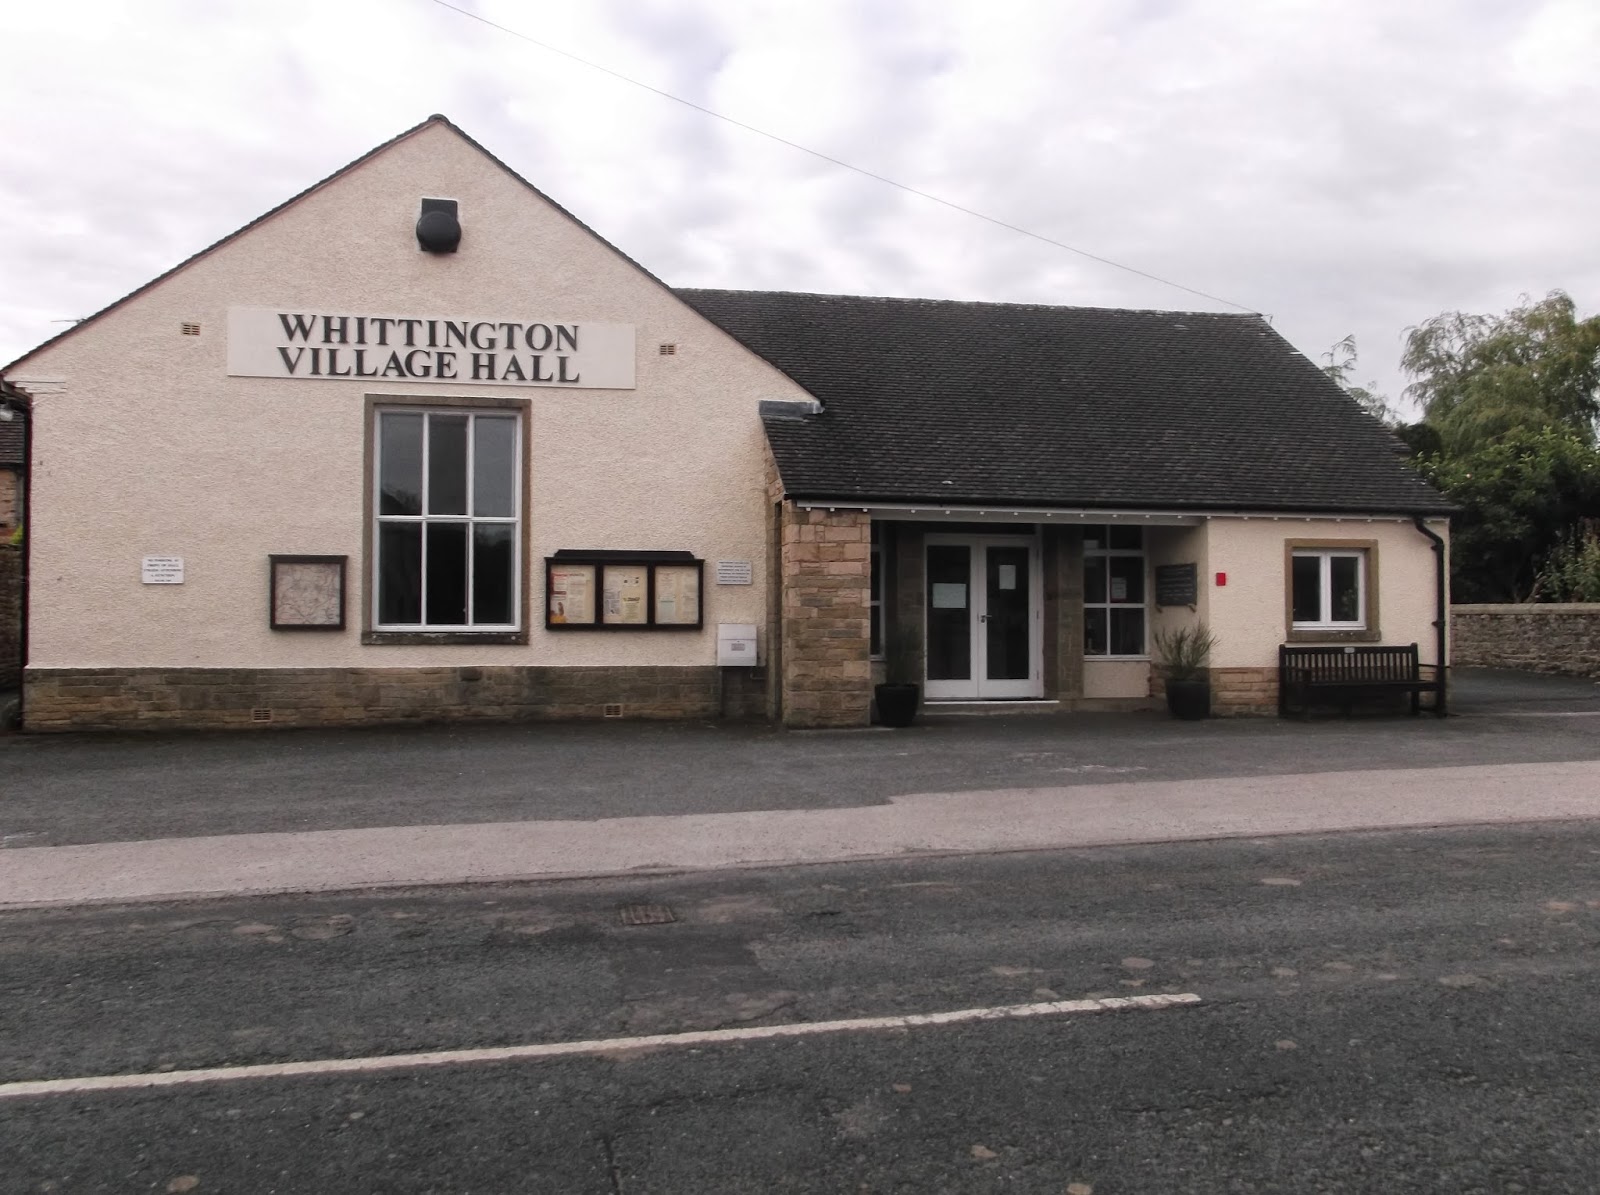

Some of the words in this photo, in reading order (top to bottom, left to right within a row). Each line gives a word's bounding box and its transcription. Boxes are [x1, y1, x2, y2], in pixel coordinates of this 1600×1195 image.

[277, 313, 579, 351] WHITTINGTON
[276, 346, 458, 379] VILLAGE
[470, 352, 580, 383] HALL
